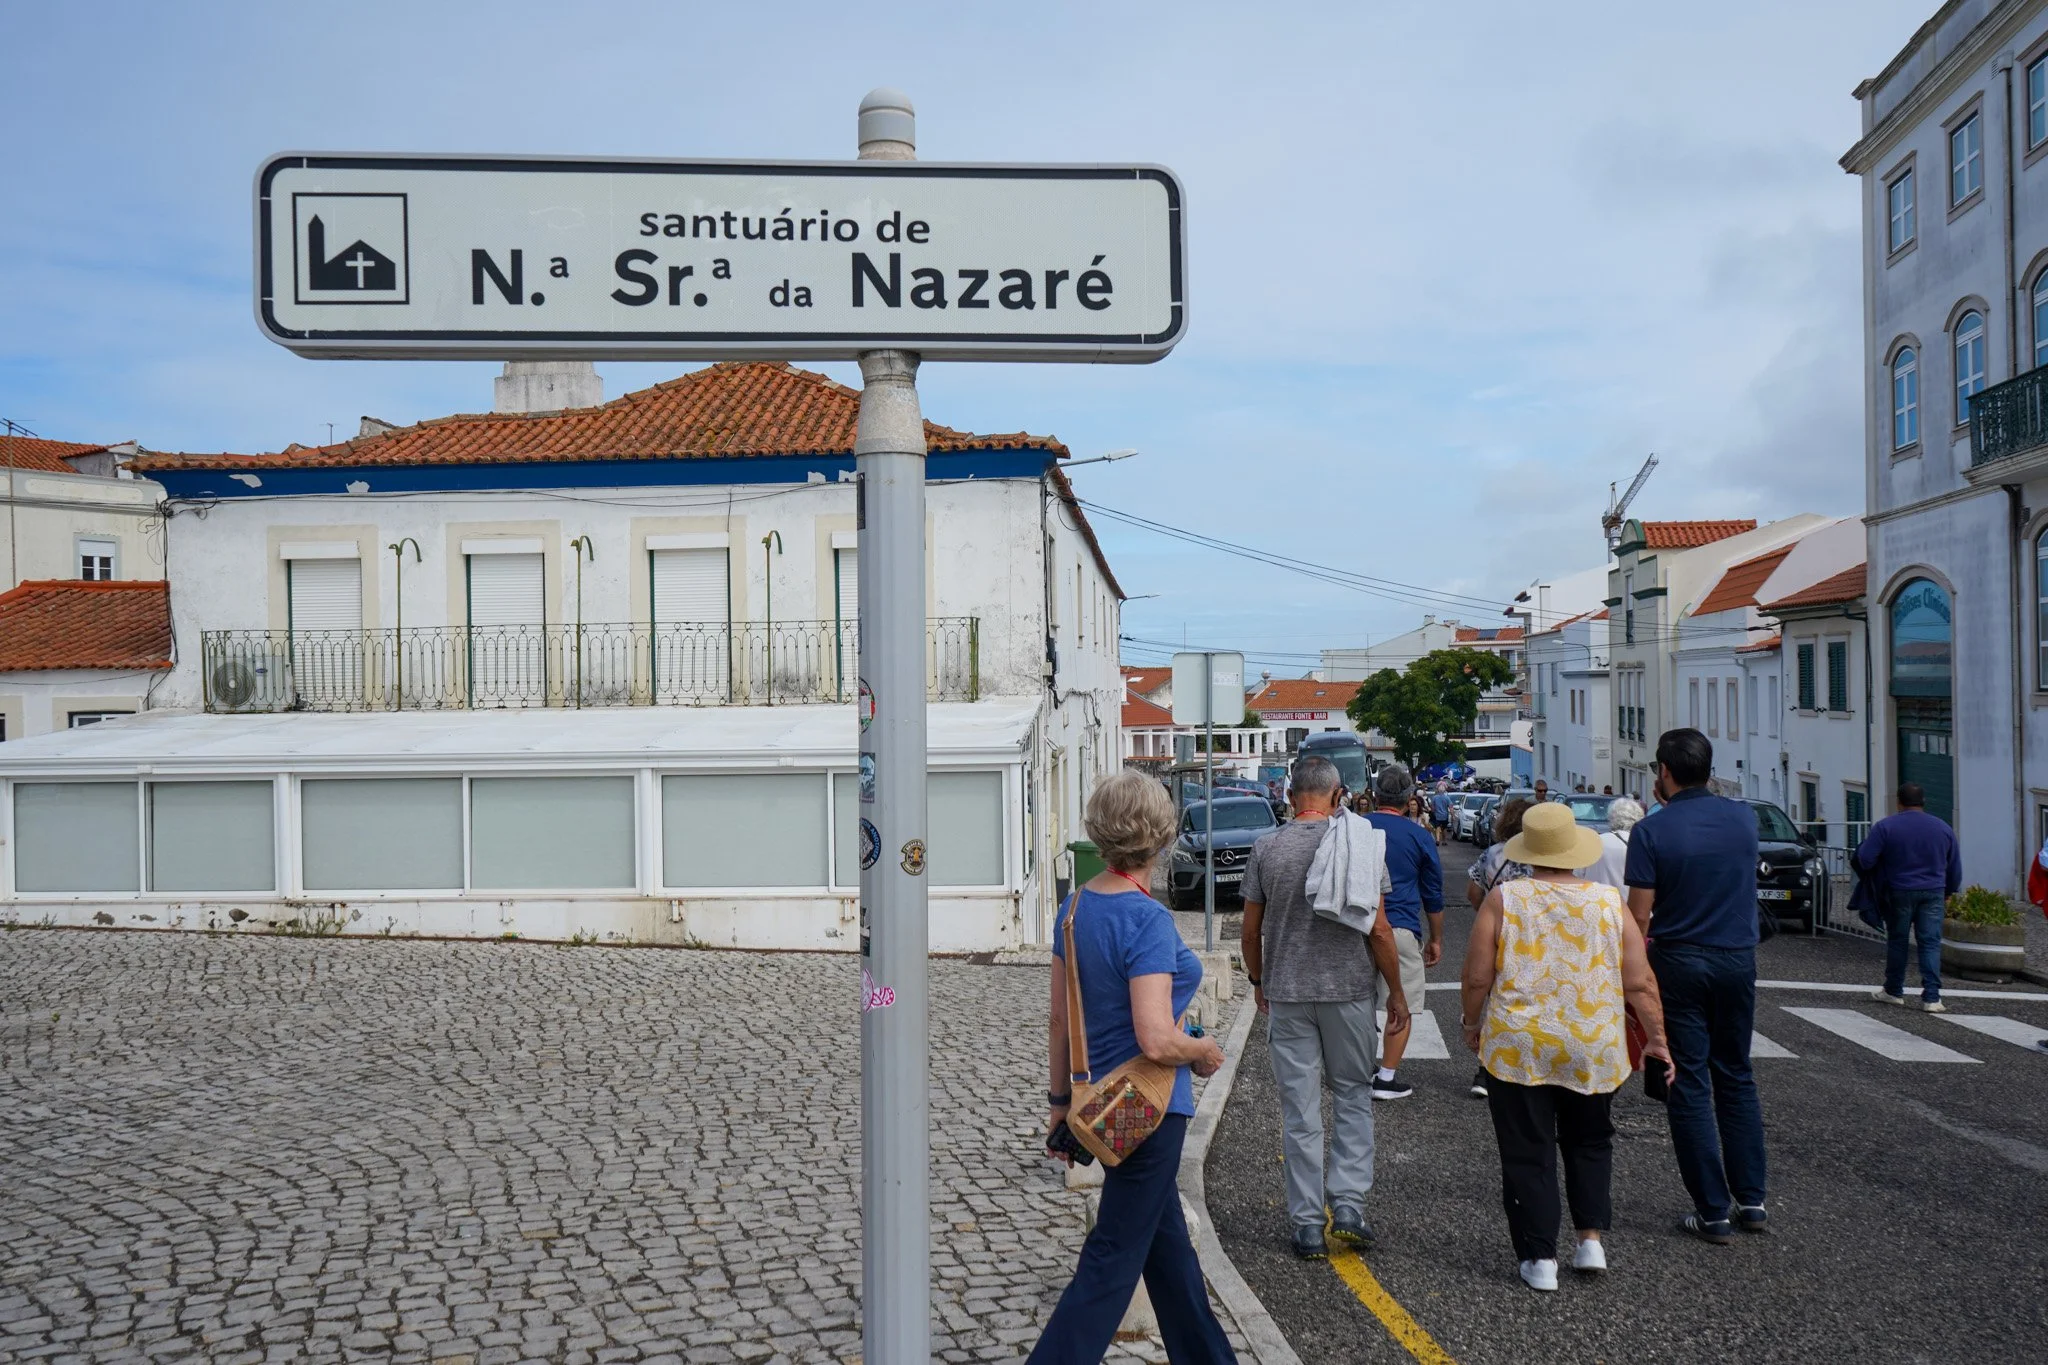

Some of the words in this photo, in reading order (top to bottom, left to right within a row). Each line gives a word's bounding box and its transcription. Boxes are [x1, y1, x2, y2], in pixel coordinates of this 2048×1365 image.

[640, 207, 860, 243] santuário
[877, 210, 930, 243] de
[770, 278, 813, 308] da
[852, 252, 1113, 311] Nazaré
[1262, 712, 1294, 720] RESTAURANTE
[1294, 712, 1311, 720] FONTE
[1314, 712, 1327, 720] MAR
